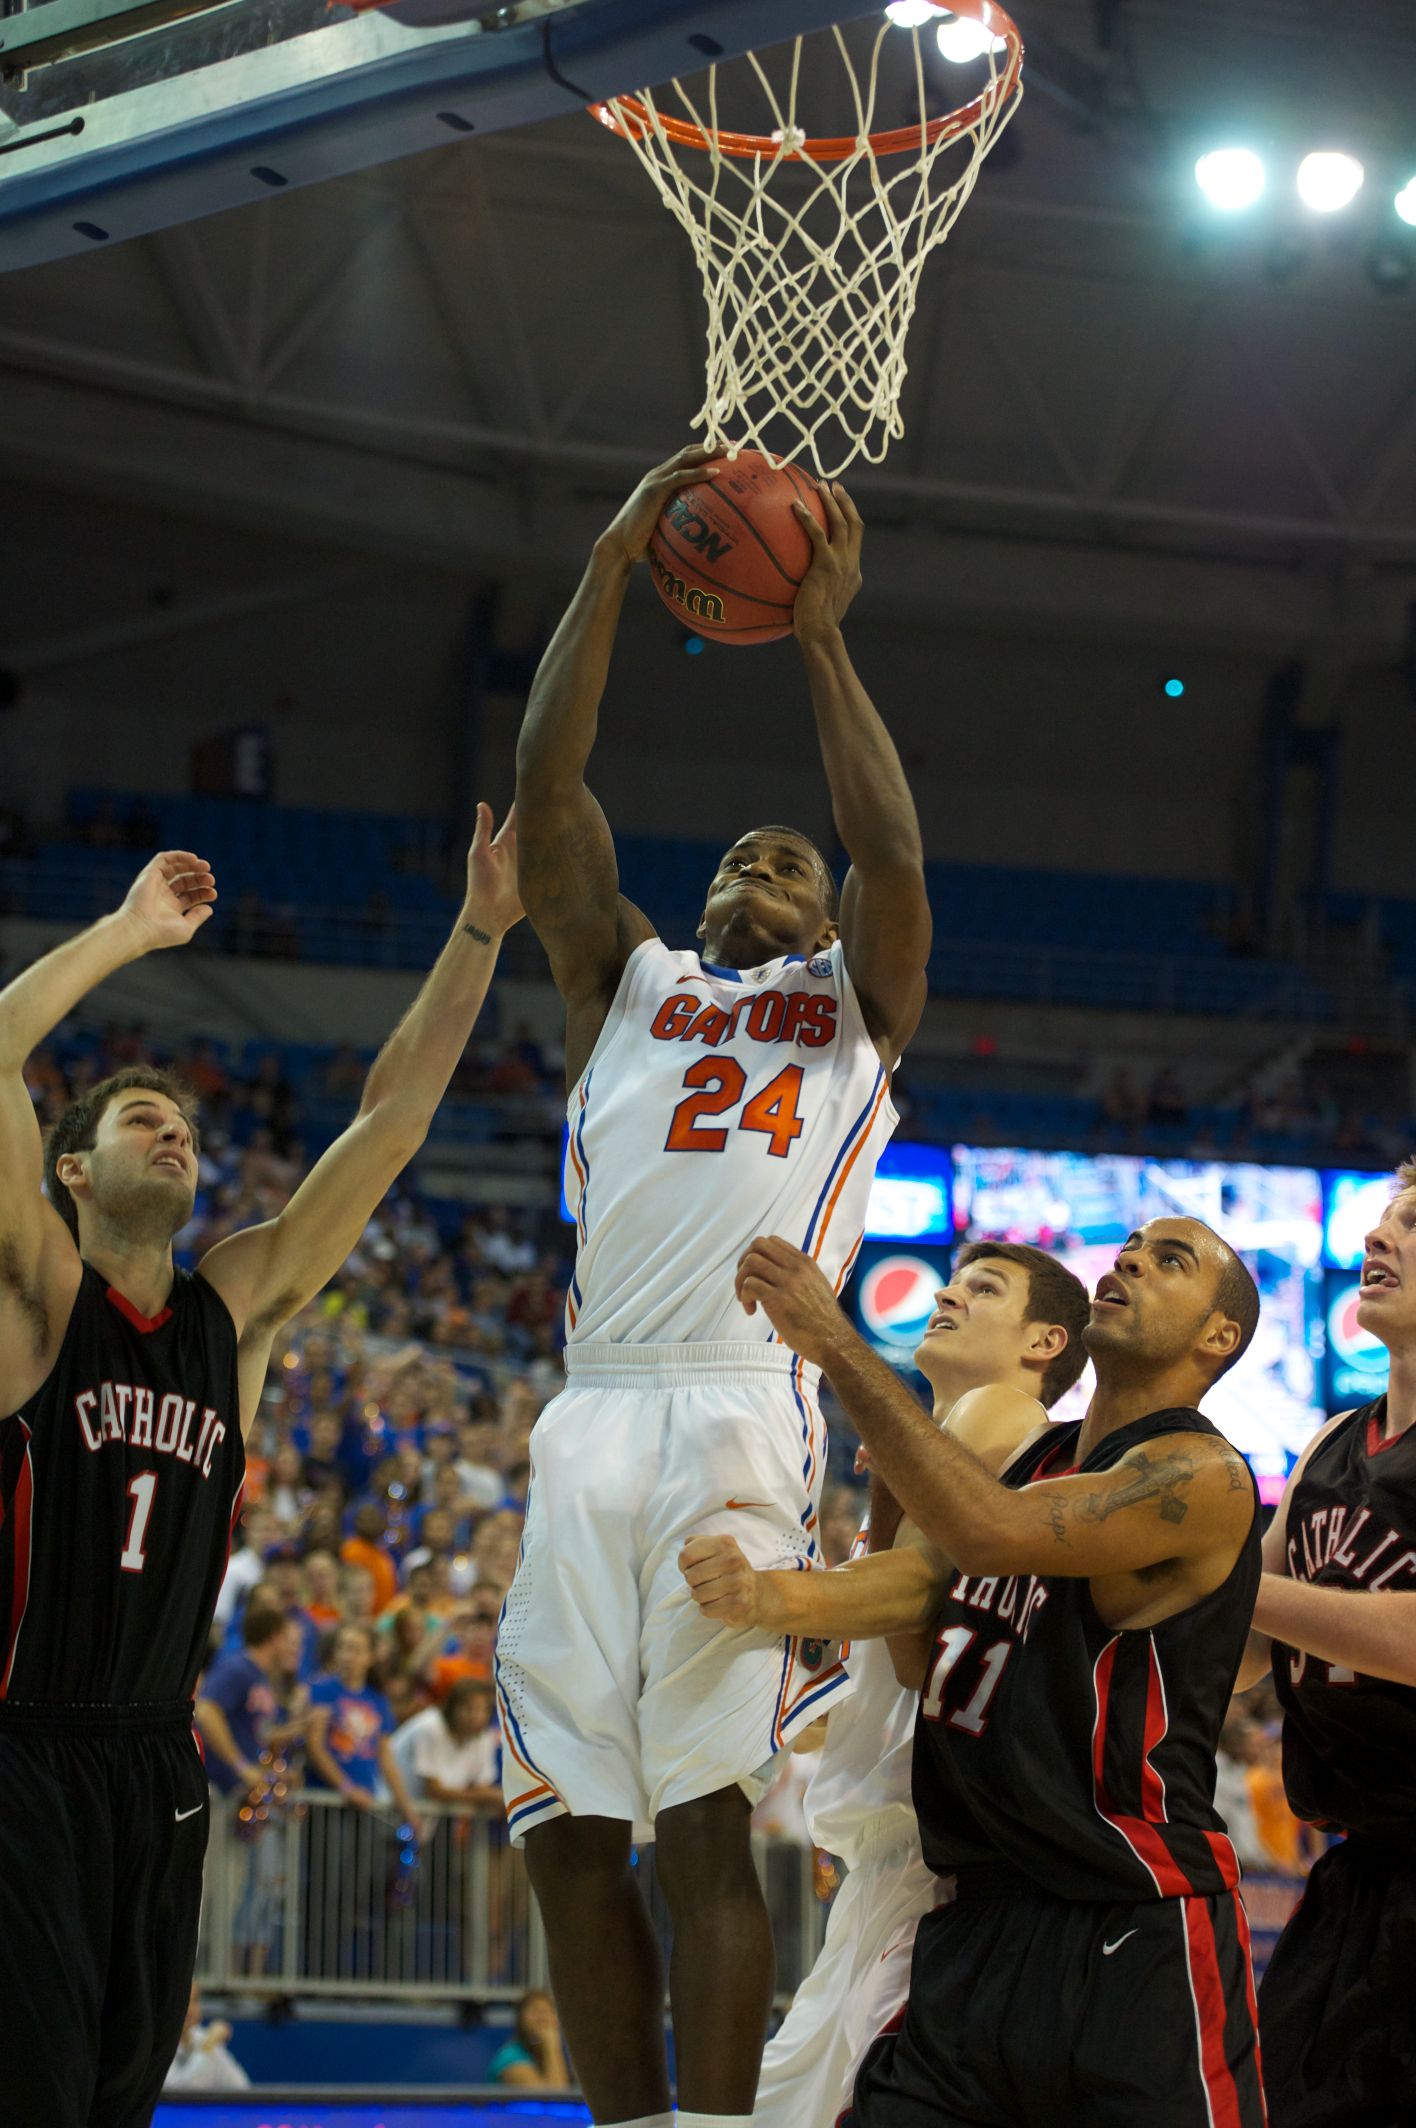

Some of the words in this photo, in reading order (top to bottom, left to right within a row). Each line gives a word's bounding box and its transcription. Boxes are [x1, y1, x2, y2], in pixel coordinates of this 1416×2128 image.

[650, 990, 838, 1048] GATORS
[663, 1054, 805, 1158] 24
[75, 1379, 226, 1480] CATHOLIC
[120, 1469, 159, 1574] 1
[1285, 1504, 1416, 1594] CATHLIC
[922, 1623, 1015, 1738] 11
